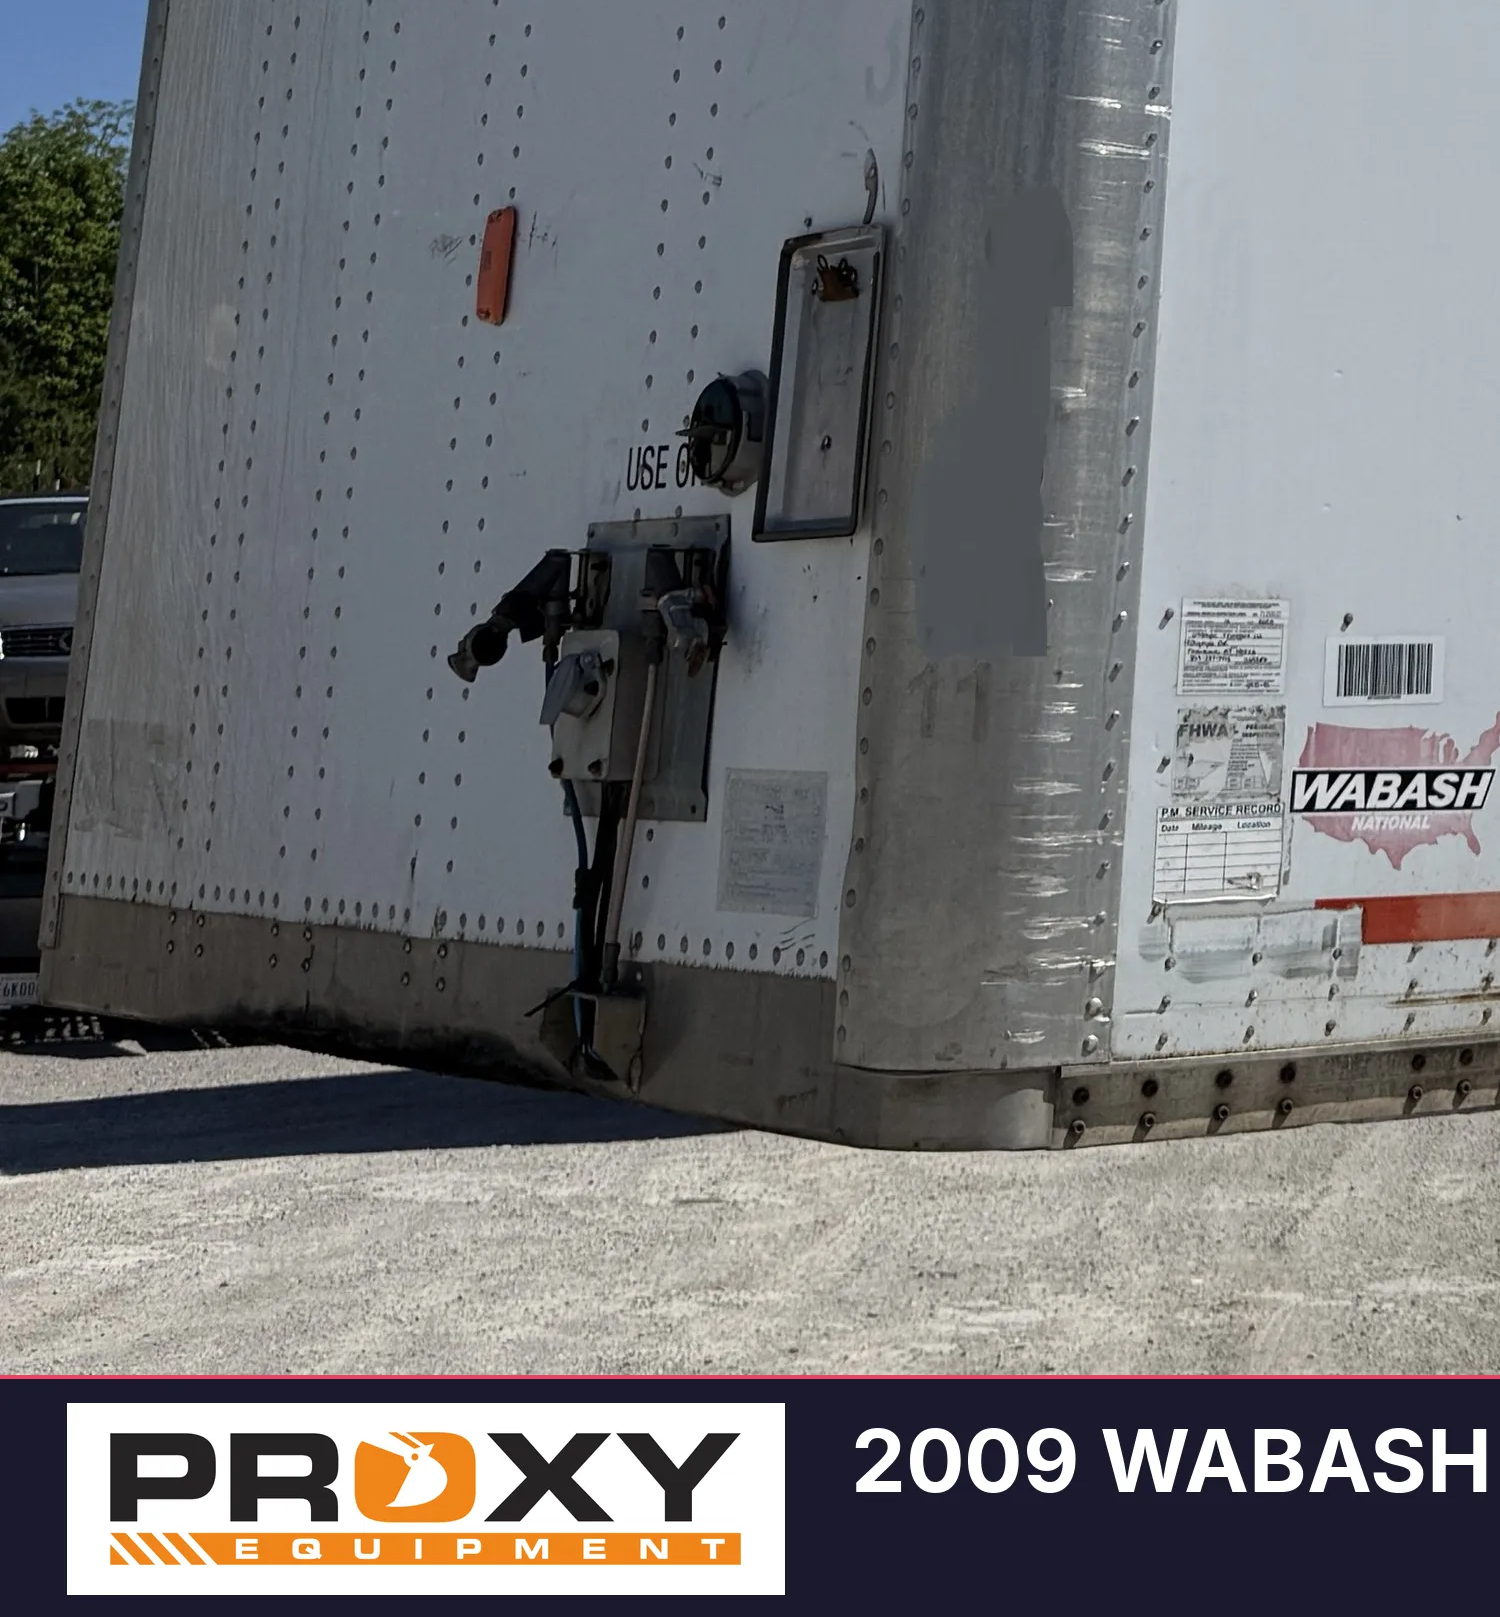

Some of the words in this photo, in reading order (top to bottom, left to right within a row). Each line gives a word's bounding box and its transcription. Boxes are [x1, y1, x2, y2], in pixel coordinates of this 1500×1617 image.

[627, 444, 670, 491] USE
[1177, 723, 1229, 738] FHWA
[1293, 771, 1493, 811] WABASH
[1185, 804, 1233, 816] SERVICE
[1236, 802, 1281, 814] RECORD
[1161, 824, 1180, 832] Date
[1191, 823, 1223, 831] Mileage
[1237, 820, 1272, 829] Location
[1351, 814, 1431, 831] NATIONAL
